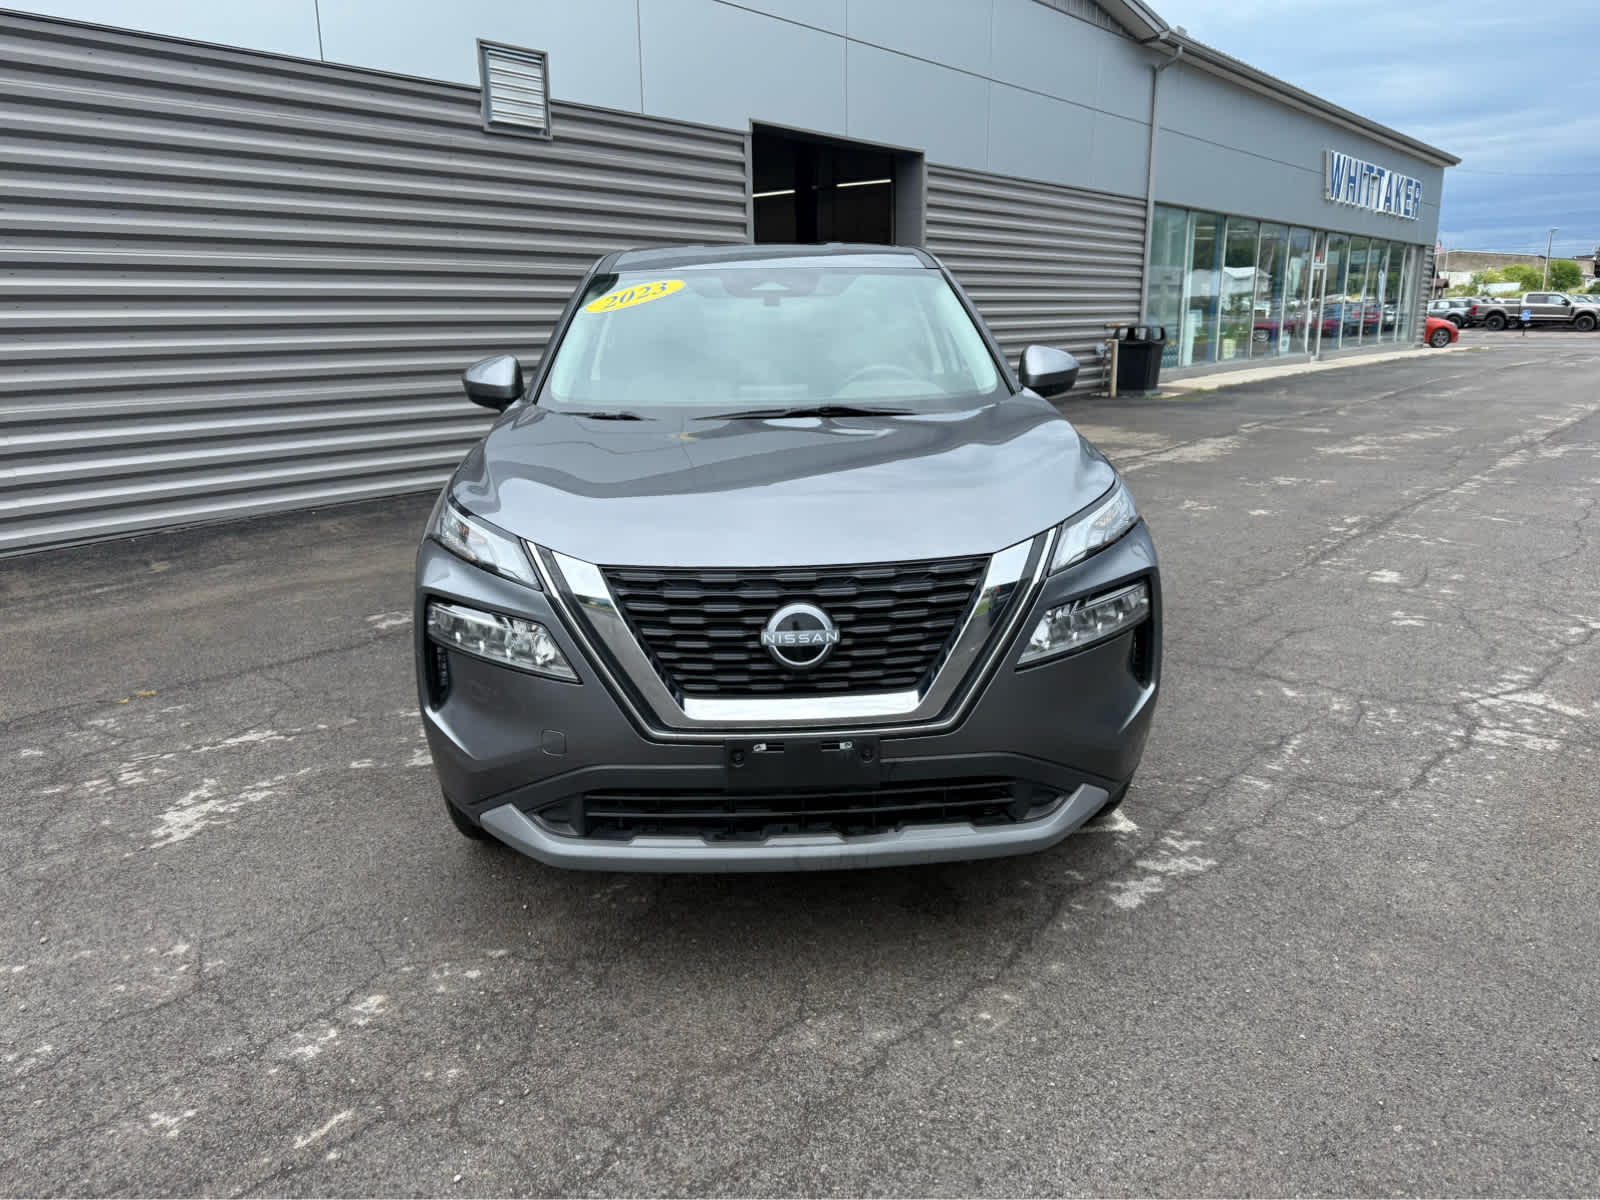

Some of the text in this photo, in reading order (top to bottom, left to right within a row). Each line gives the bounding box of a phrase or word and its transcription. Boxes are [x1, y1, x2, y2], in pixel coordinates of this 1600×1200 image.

[1328, 150, 1422, 220] WHITTAKER
[603, 282, 668, 309] 2023
[763, 631, 838, 644] NISSAN
